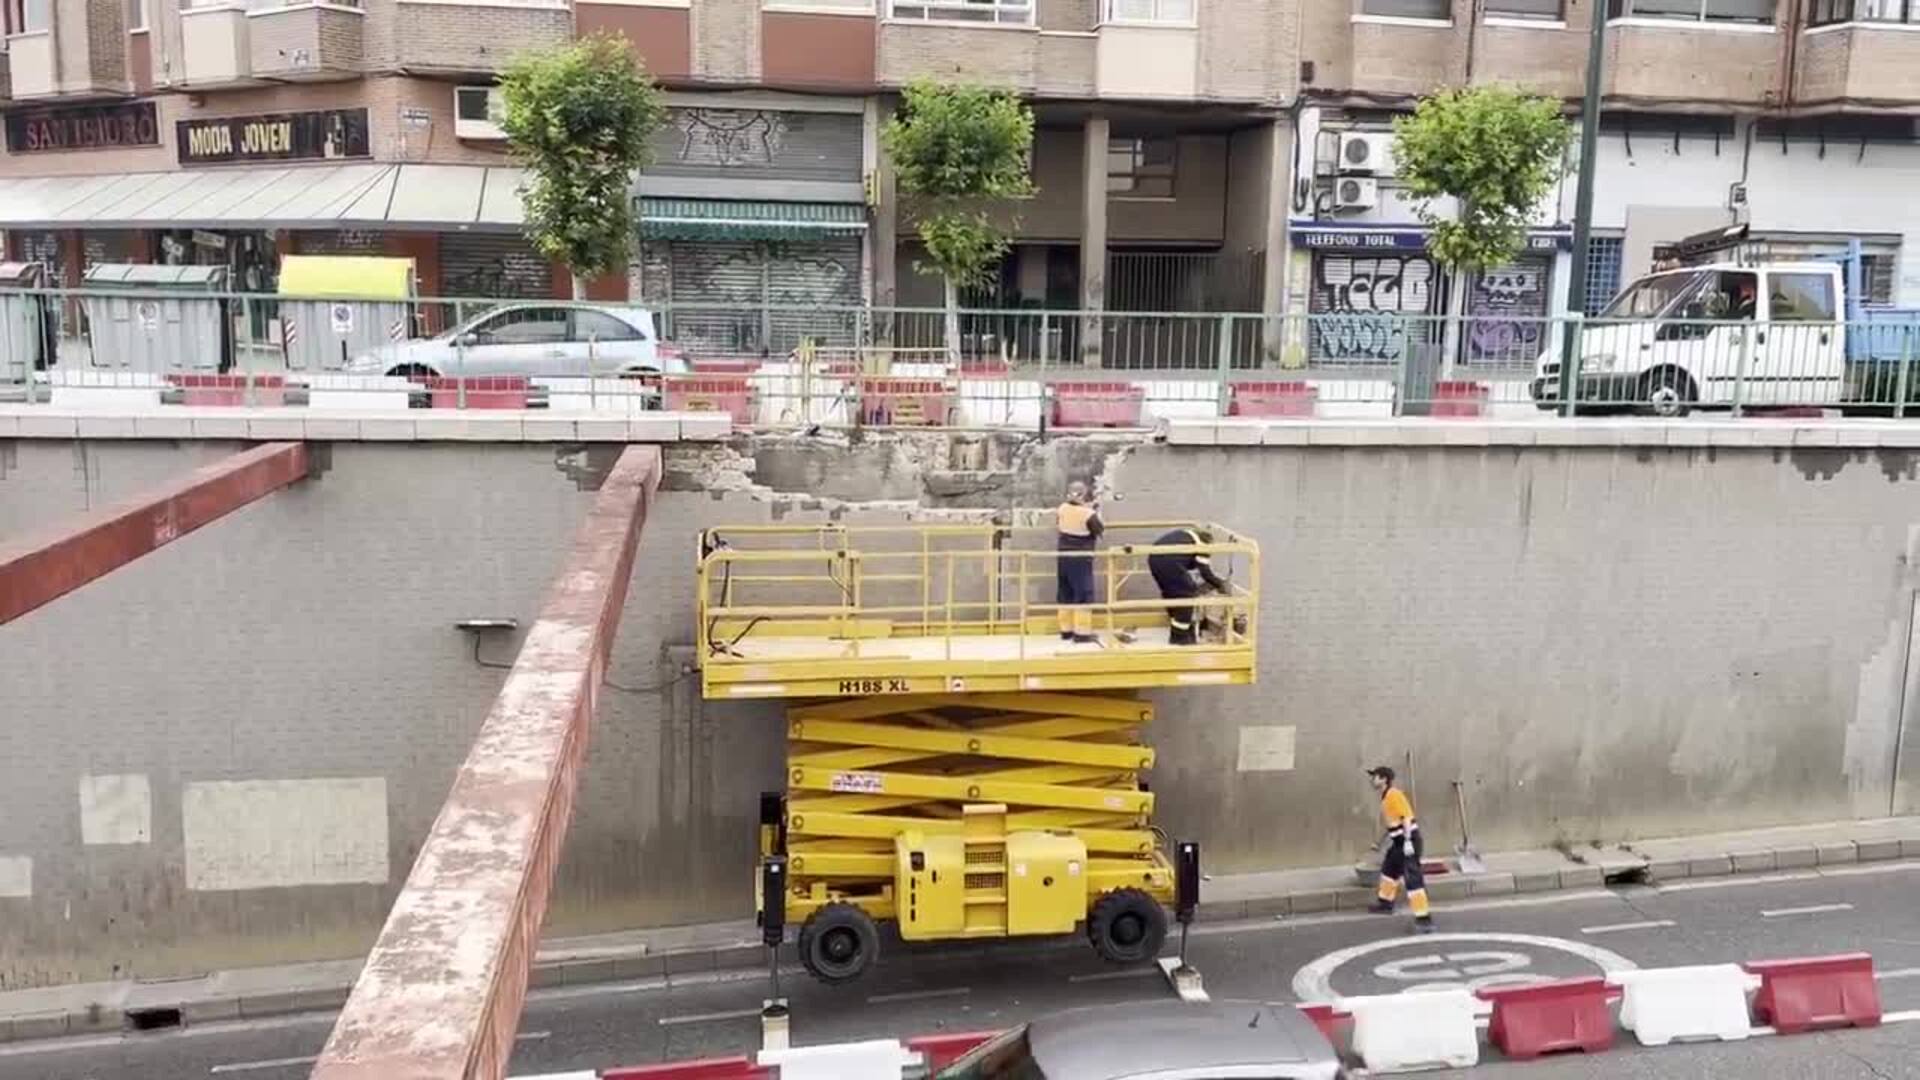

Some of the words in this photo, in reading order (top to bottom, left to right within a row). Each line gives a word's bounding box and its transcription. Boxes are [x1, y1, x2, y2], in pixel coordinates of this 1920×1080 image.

[26, 118, 68, 150] SAN
[188, 125, 233, 156] MODA
[241, 121, 291, 153] JOVEN
[1364, 234, 1396, 246] TOTAL
[839, 680, 882, 693] H18S
[889, 679, 910, 692] XL
